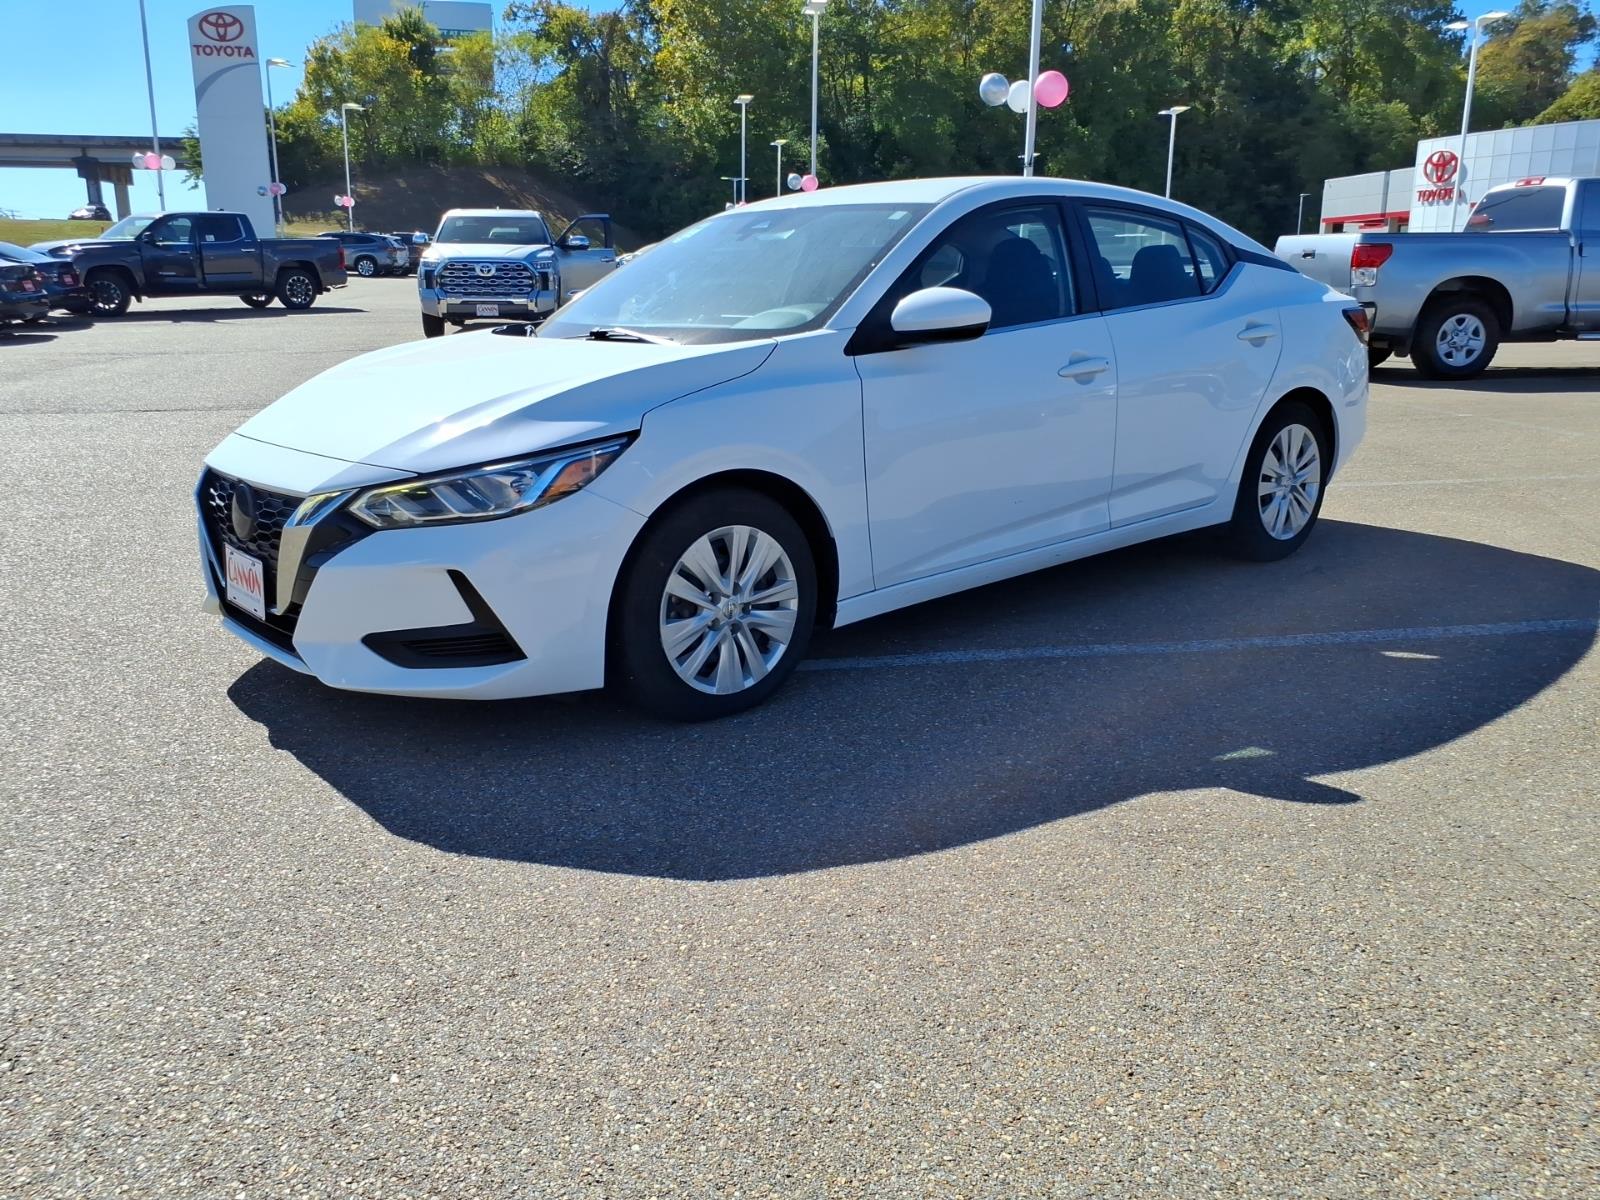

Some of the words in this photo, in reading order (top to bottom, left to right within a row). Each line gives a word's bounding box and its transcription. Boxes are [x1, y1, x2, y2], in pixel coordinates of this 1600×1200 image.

[193, 45, 254, 57] TOYOTA
[1417, 187, 1461, 202] TOYOT
[228, 557, 262, 598] CANNON
